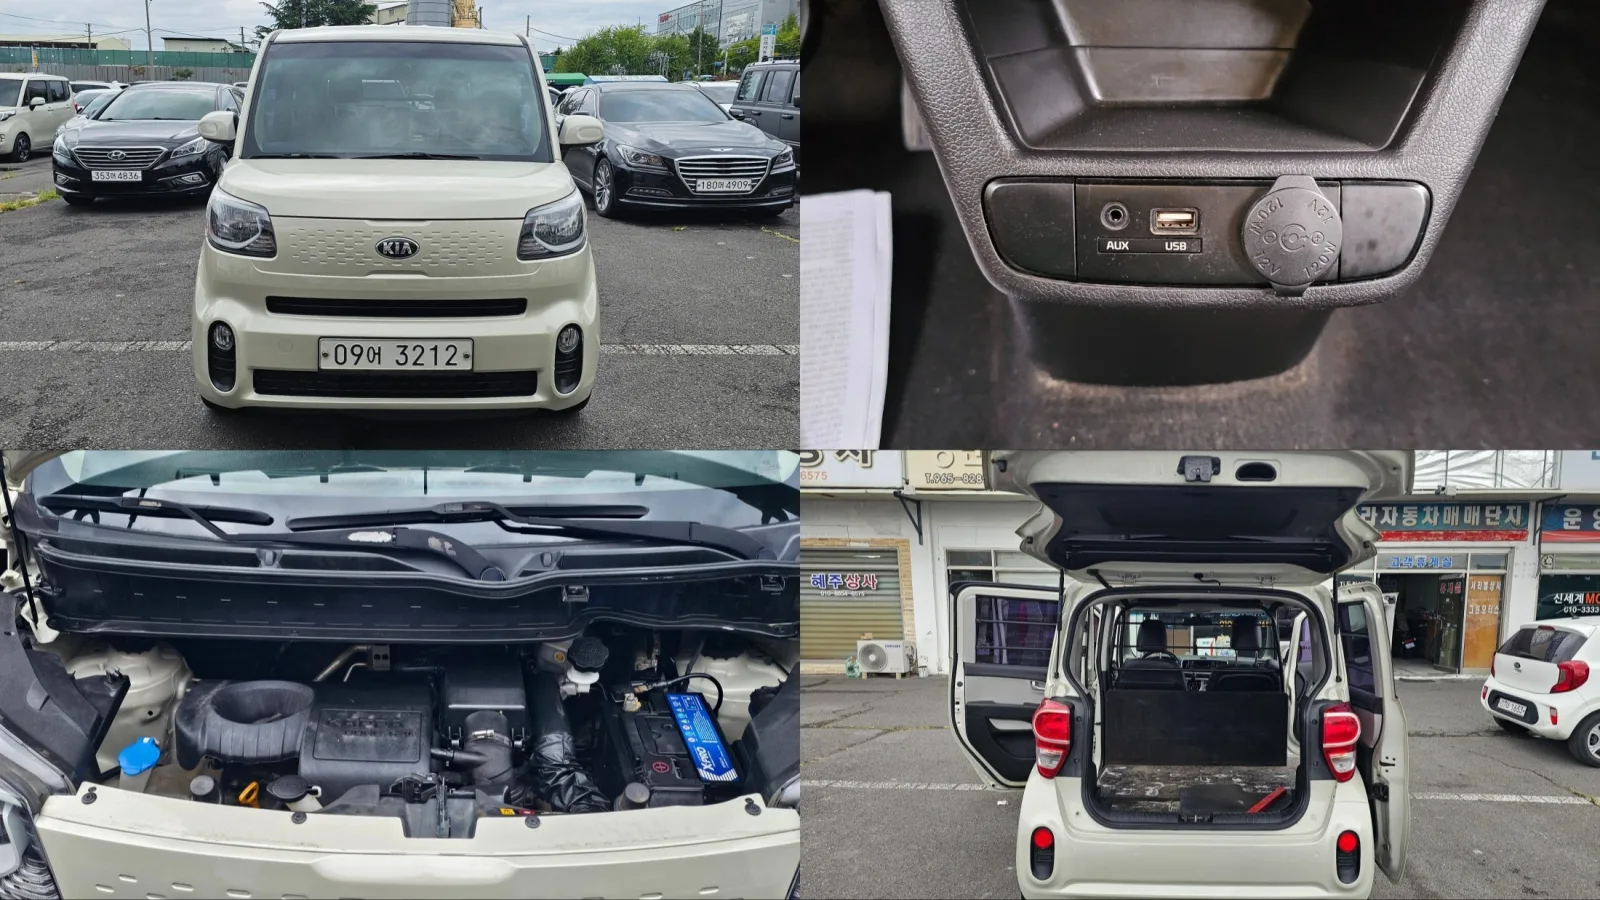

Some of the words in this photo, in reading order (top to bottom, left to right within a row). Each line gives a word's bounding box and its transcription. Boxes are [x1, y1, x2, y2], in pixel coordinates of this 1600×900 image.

[117, 171, 139, 180] 4836
[725, 180, 749, 190] 4909
[1249, 197, 1284, 236] 120W
[1307, 198, 1334, 225] 12V
[382, 241, 413, 255] KIA
[1106, 240, 1130, 251] AUX
[1164, 241, 1187, 251] USB
[1254, 250, 1281, 276] 12V
[1303, 241, 1337, 279] 120W
[334, 343, 382, 366] 09어
[395, 344, 458, 367] 3212
[800, 471, 828, 480] 6575
[925, 472, 985, 484] T.965-828
[1361, 505, 1522, 527] 라자동차매매단지
[1389, 555, 1453, 569] 고객휴게실
[810, 572, 878, 590] 혜주상사
